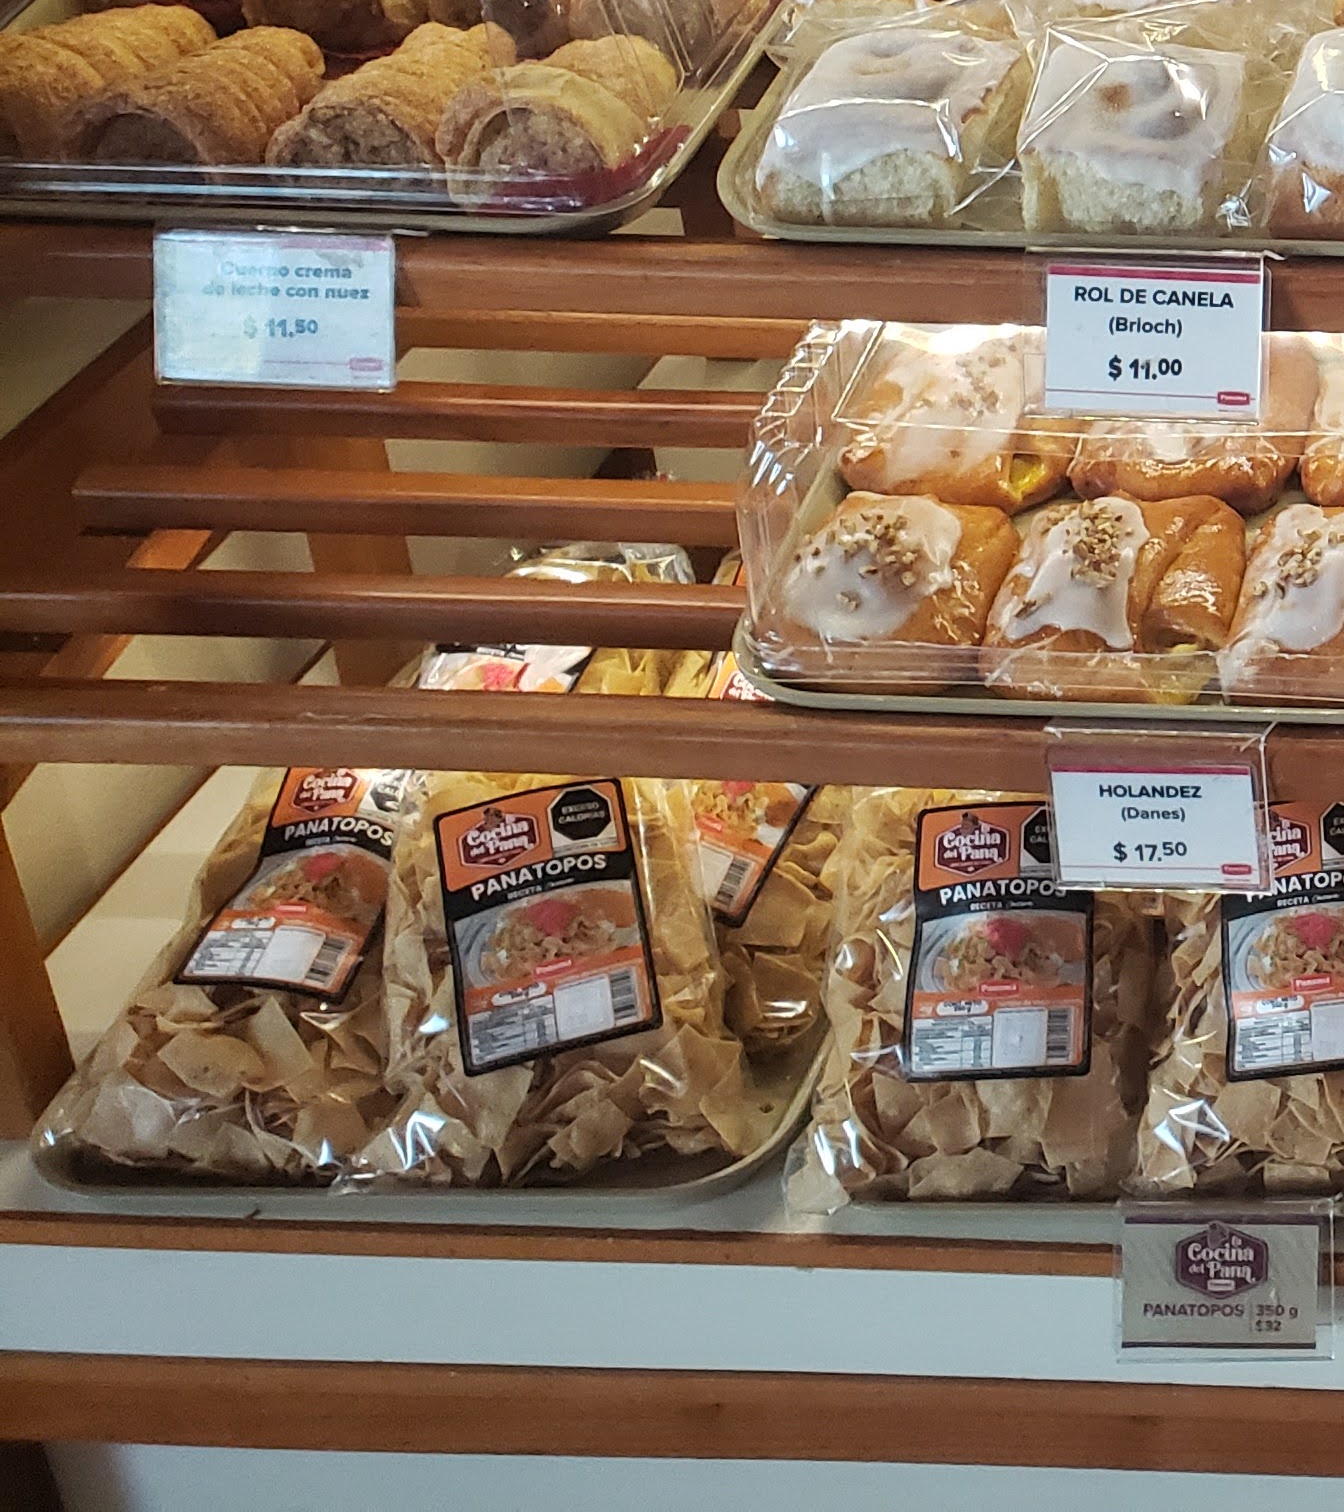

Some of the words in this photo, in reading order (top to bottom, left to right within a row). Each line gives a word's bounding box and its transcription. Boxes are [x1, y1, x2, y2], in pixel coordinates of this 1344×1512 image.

[294, 264, 352, 279] crema
[286, 285, 319, 298] con
[325, 287, 370, 300] nuez
[1074, 285, 1113, 303] ROL
[1120, 288, 1147, 304] DE
[1152, 290, 1234, 308] CANELA
[264, 319, 319, 338] 11.50
[1108, 316, 1183, 338] (Brioch)
[1108, 354, 1122, 381] $
[1129, 358, 1182, 380] 11.00
[1099, 784, 1203, 799] HOLANDEZ
[1121, 806, 1186, 822] (Danes)
[284, 816, 395, 847] PANATOPOS
[467, 820, 529, 846] Cocina
[943, 829, 1001, 848] Cocina
[1113, 841, 1128, 863] $
[1134, 841, 1188, 862] 17.50
[470, 854, 608, 901] PANATOPOS
[1276, 895, 1310, 908] RECETA
[1187, 1242, 1255, 1262] Cocina
[1143, 1303, 1245, 1318] PANATOPOS
[1255, 1303, 1285, 1317] 350
[1289, 1306, 1299, 1319] g
